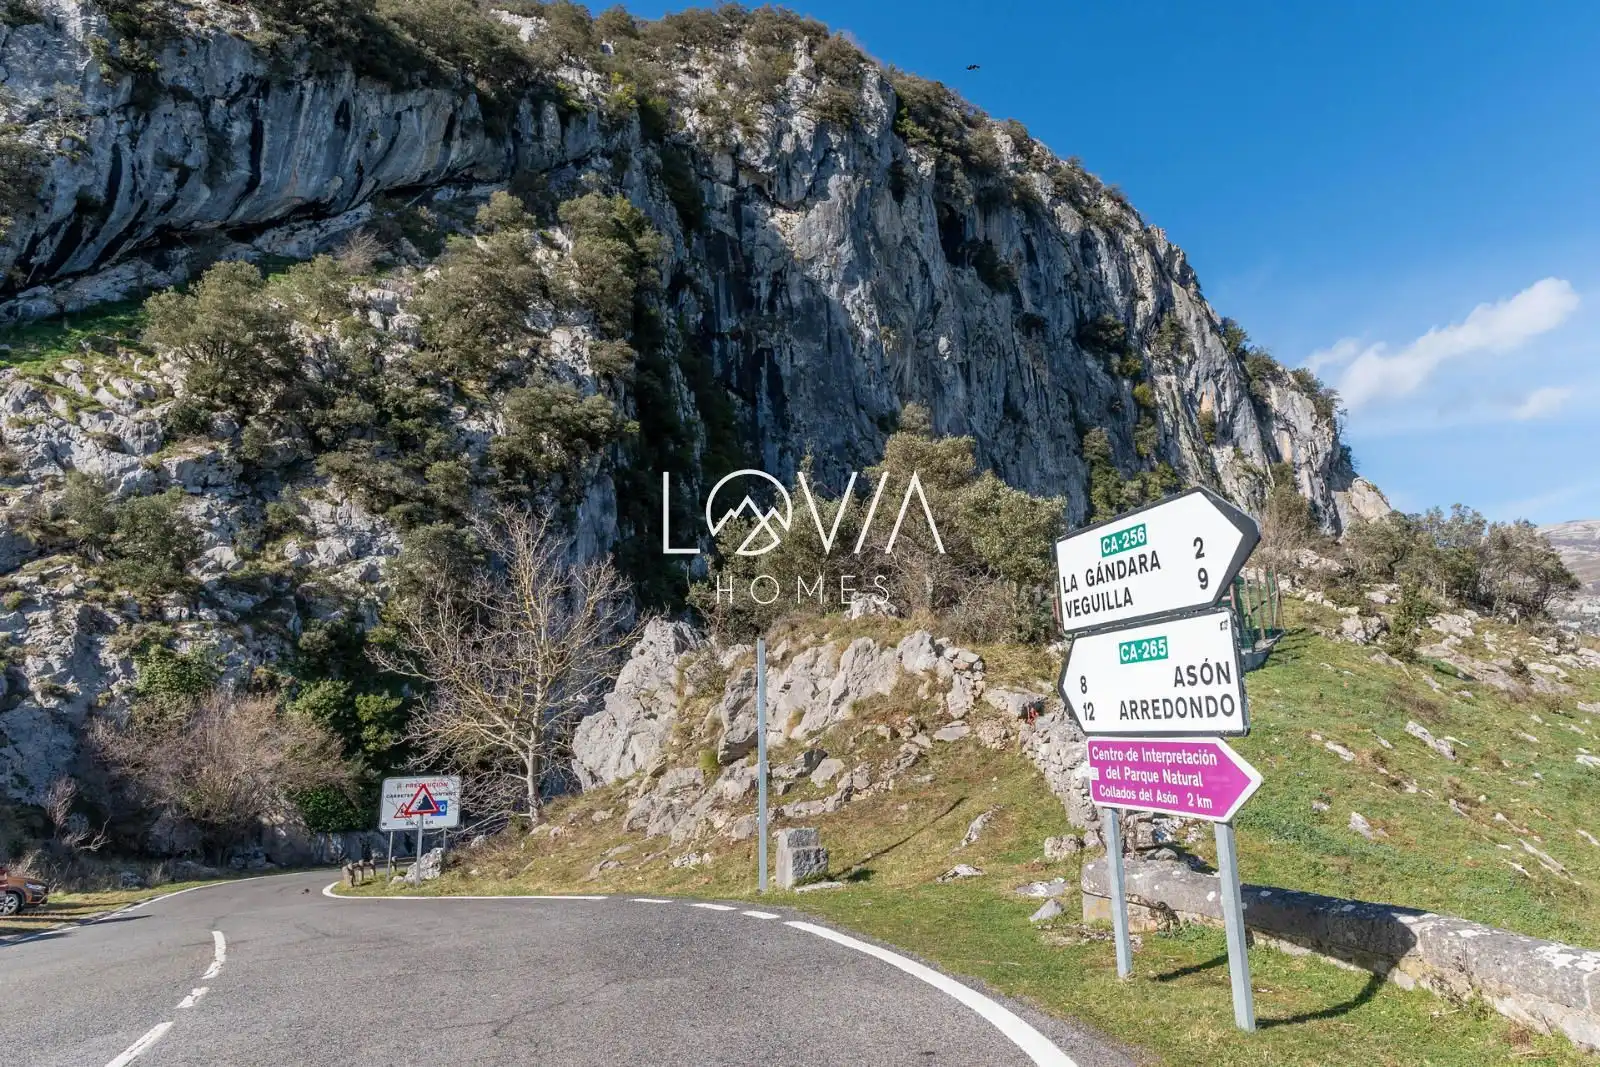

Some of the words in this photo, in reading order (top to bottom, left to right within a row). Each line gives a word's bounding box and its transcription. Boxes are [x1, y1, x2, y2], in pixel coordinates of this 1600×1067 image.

[1102, 526, 1145, 554] CA-256
[1063, 574, 1078, 594] LA
[1086, 550, 1161, 587] GÁNDARA
[1193, 537, 1205, 559] 2
[1065, 587, 1133, 618] VEGUILLA
[1197, 567, 1209, 589] 9
[1120, 638, 1167, 661] CA-265
[1080, 675, 1088, 694] 8
[1174, 658, 1232, 687] ASÓN
[1083, 702, 1095, 721] 12
[1119, 693, 1235, 720] ARREDONDO
[1092, 746, 1124, 761] Centro
[1126, 748, 1138, 762] de
[1142, 748, 1217, 766] Interpretación
[1106, 765, 1121, 780] del
[1124, 767, 1159, 784] Parque
[1162, 768, 1204, 787] Natural
[1099, 785, 1136, 800] Collados
[1139, 788, 1153, 801] del
[1156, 789, 1178, 805] Asón
[1187, 792, 1194, 807] 2
[1197, 795, 1213, 809] km
